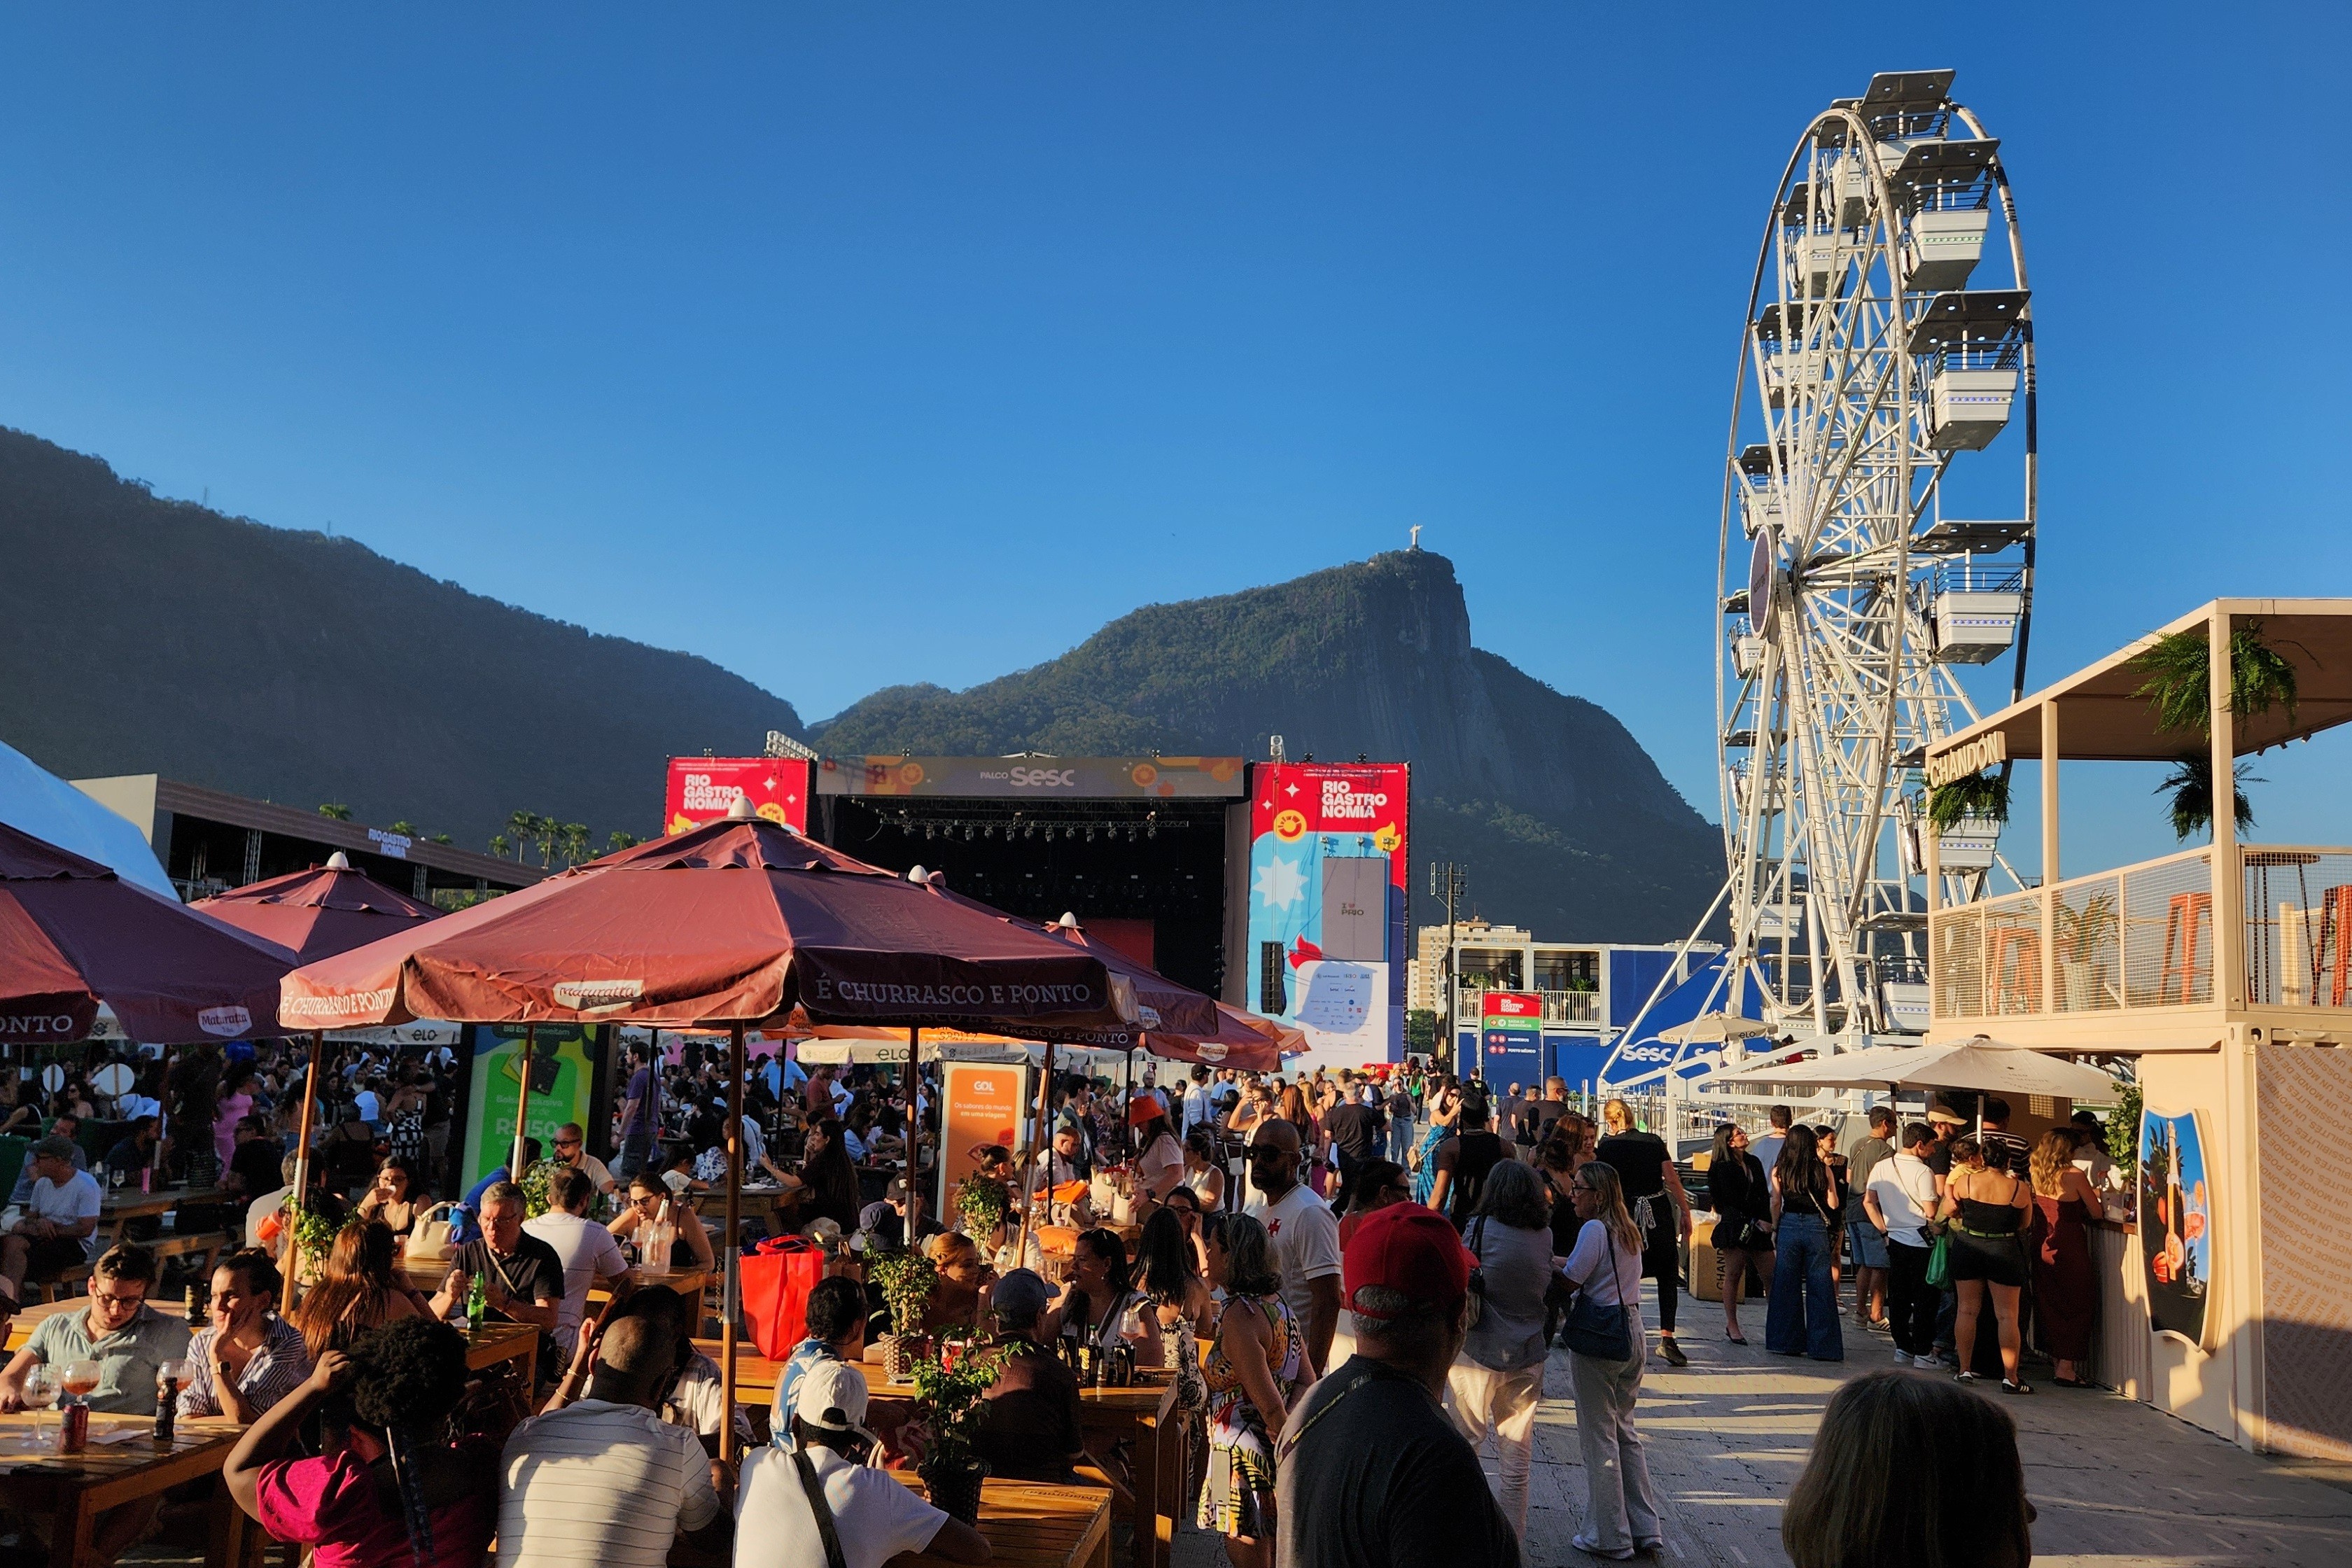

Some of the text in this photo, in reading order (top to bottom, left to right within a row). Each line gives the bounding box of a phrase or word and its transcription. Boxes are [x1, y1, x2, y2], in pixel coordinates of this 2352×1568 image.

[1930, 731, 2000, 788] CHANDON
[685, 774, 711, 785] RIO
[1009, 766, 1074, 786] Sesc
[683, 786, 743, 798] GASTRO
[1322, 781, 1350, 793] RIO
[683, 798, 732, 809] NOMIA
[1322, 793, 1387, 806] GASTRO
[1322, 805, 1376, 818] NOMIA
[368, 828, 412, 848] RIO GASTRO
[381, 842, 406, 859] NOMIA
[559, 986, 635, 998] Maturatta
[816, 972, 1091, 1004] É CHURRASCO E PONTO
[281, 992, 293, 1014] É
[291, 994, 350, 1016] CHURRASCO
[351, 993, 358, 1013] E
[1621, 1044, 1672, 1062] Sesc
[2282, 1061, 2295, 1074] DE
[2290, 1052, 2320, 1082] MONDE
[2332, 1056, 2346, 1068] UN
[2273, 1070, 2286, 1084] UN
[974, 1081, 994, 1091] GOL
[2292, 1073, 2324, 1101] MONDE
[2319, 1079, 2334, 1092] UN
[2264, 1080, 2295, 1110] MONDE
[2324, 1099, 2339, 1112] UN
[2279, 1114, 2293, 1128] UN
[2292, 1108, 2307, 1121] UN
[2266, 1120, 2297, 1147] MONDE
[2268, 1138, 2300, 1166] MONDE
[2297, 1145, 2311, 1158] UN
[2300, 1164, 2314, 1176] UN
[2283, 1168, 2348, 1209] UN MONDE DE
[2287, 1188, 2301, 1200] UN
[2268, 1190, 2333, 1233] UN MONDE DE
[2314, 1235, 2330, 1247] DE
[2299, 1242, 2313, 1254] DE
[2271, 1257, 2337, 1295] UN MONDE DE
[2327, 1270, 2342, 1282] DE
